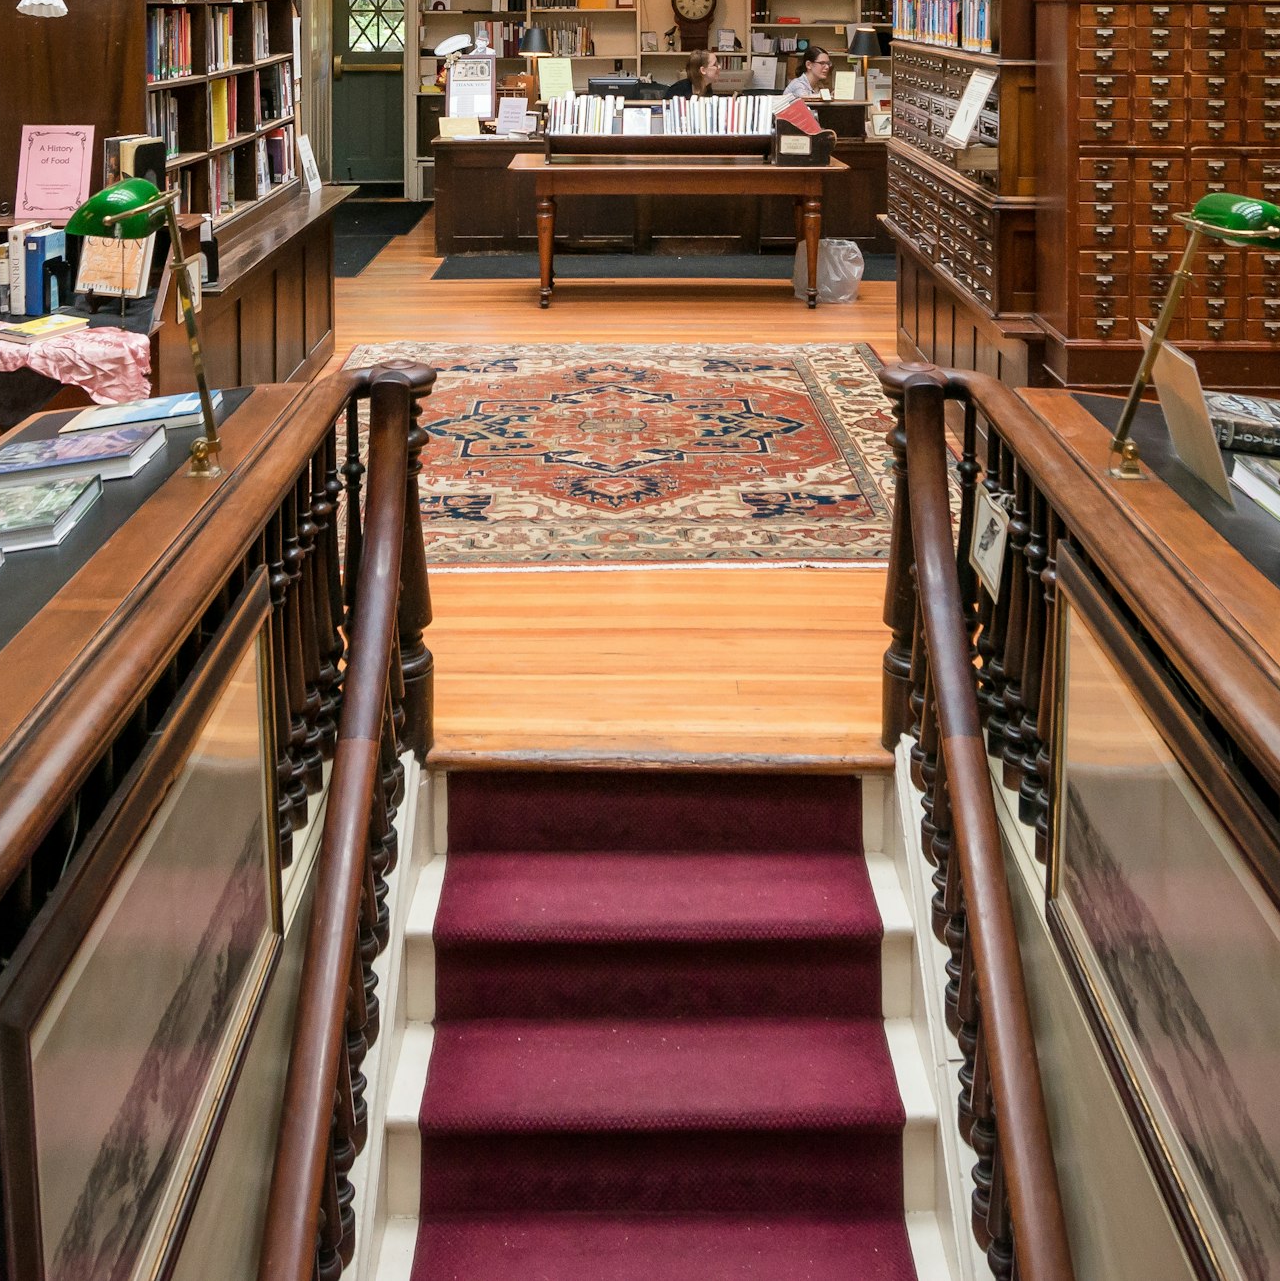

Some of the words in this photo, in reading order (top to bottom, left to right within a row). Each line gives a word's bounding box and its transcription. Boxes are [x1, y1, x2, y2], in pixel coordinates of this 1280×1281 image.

[39, 145, 46, 153] A
[47, 144, 73, 155] History
[41, 157, 48, 165] of
[49, 157, 70, 165] Food
[105, 284, 131, 294] FUSSLL
